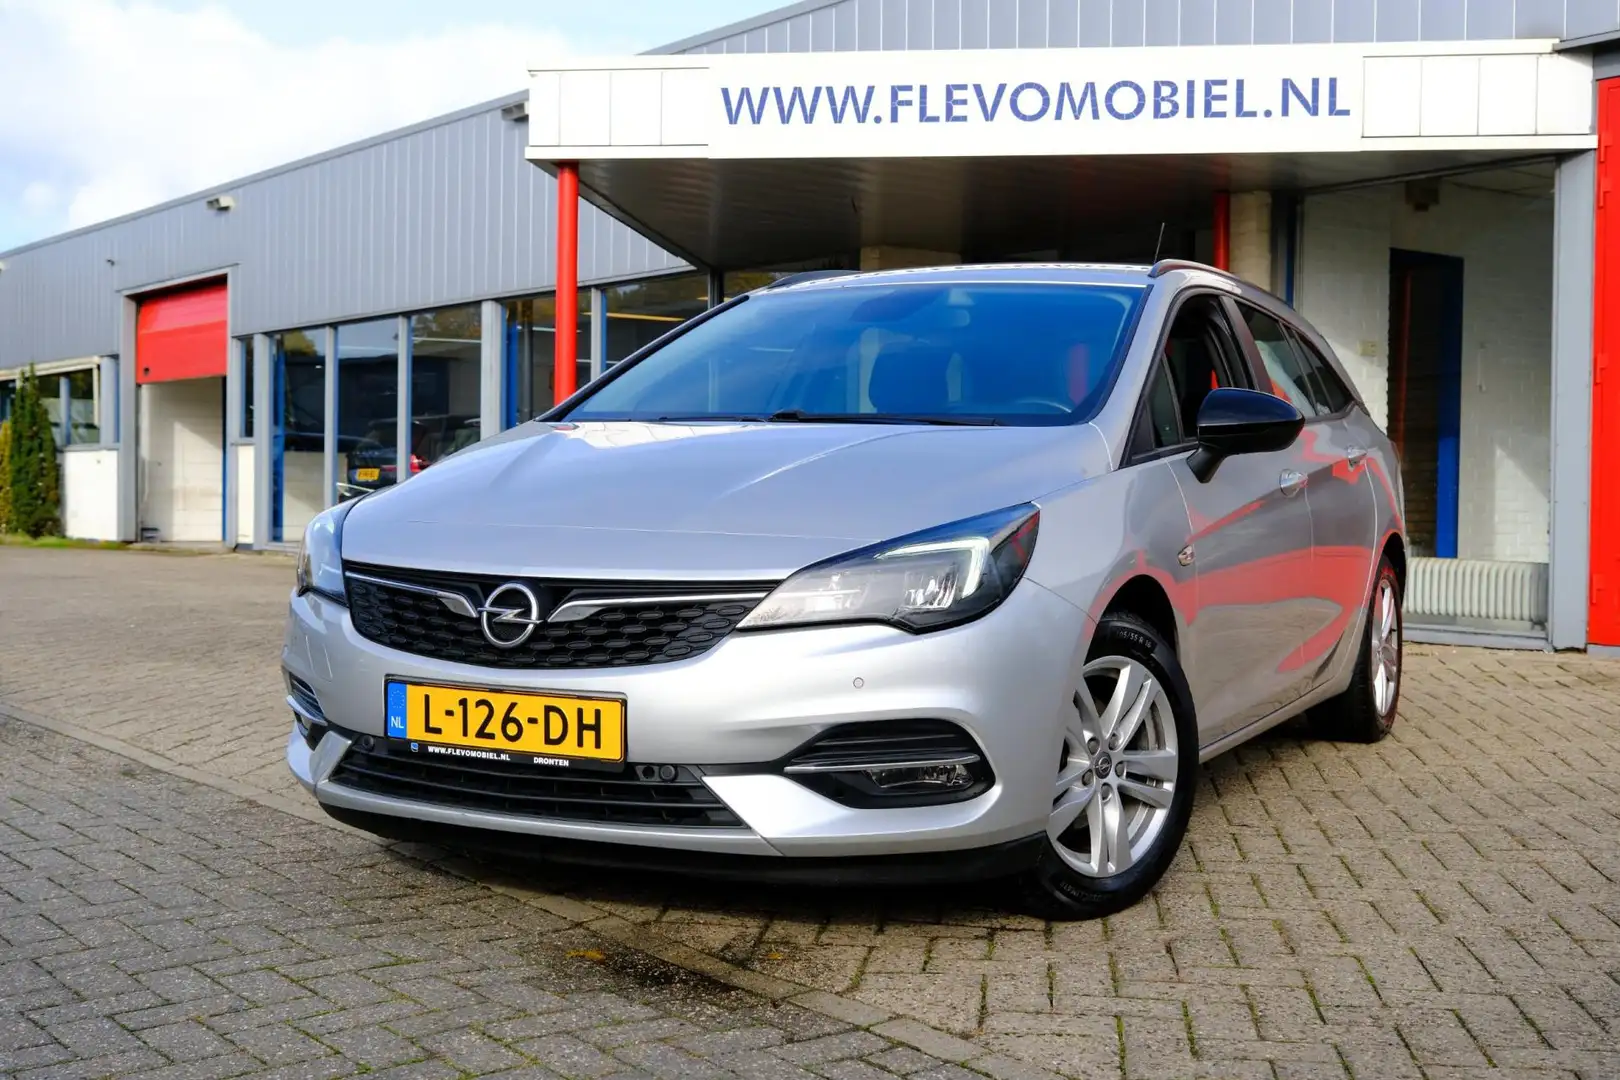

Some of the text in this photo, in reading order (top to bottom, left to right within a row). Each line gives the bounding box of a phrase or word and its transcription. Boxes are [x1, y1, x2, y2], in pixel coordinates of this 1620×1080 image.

[721, 77, 1351, 125] WWW.FLEVOMOBIEL.NL
[390, 715, 404, 729] NL
[424, 693, 602, 749] L-126-DH
[427, 745, 569, 767] WWW.FLEVOMOBIEL.NL DRONTEN
